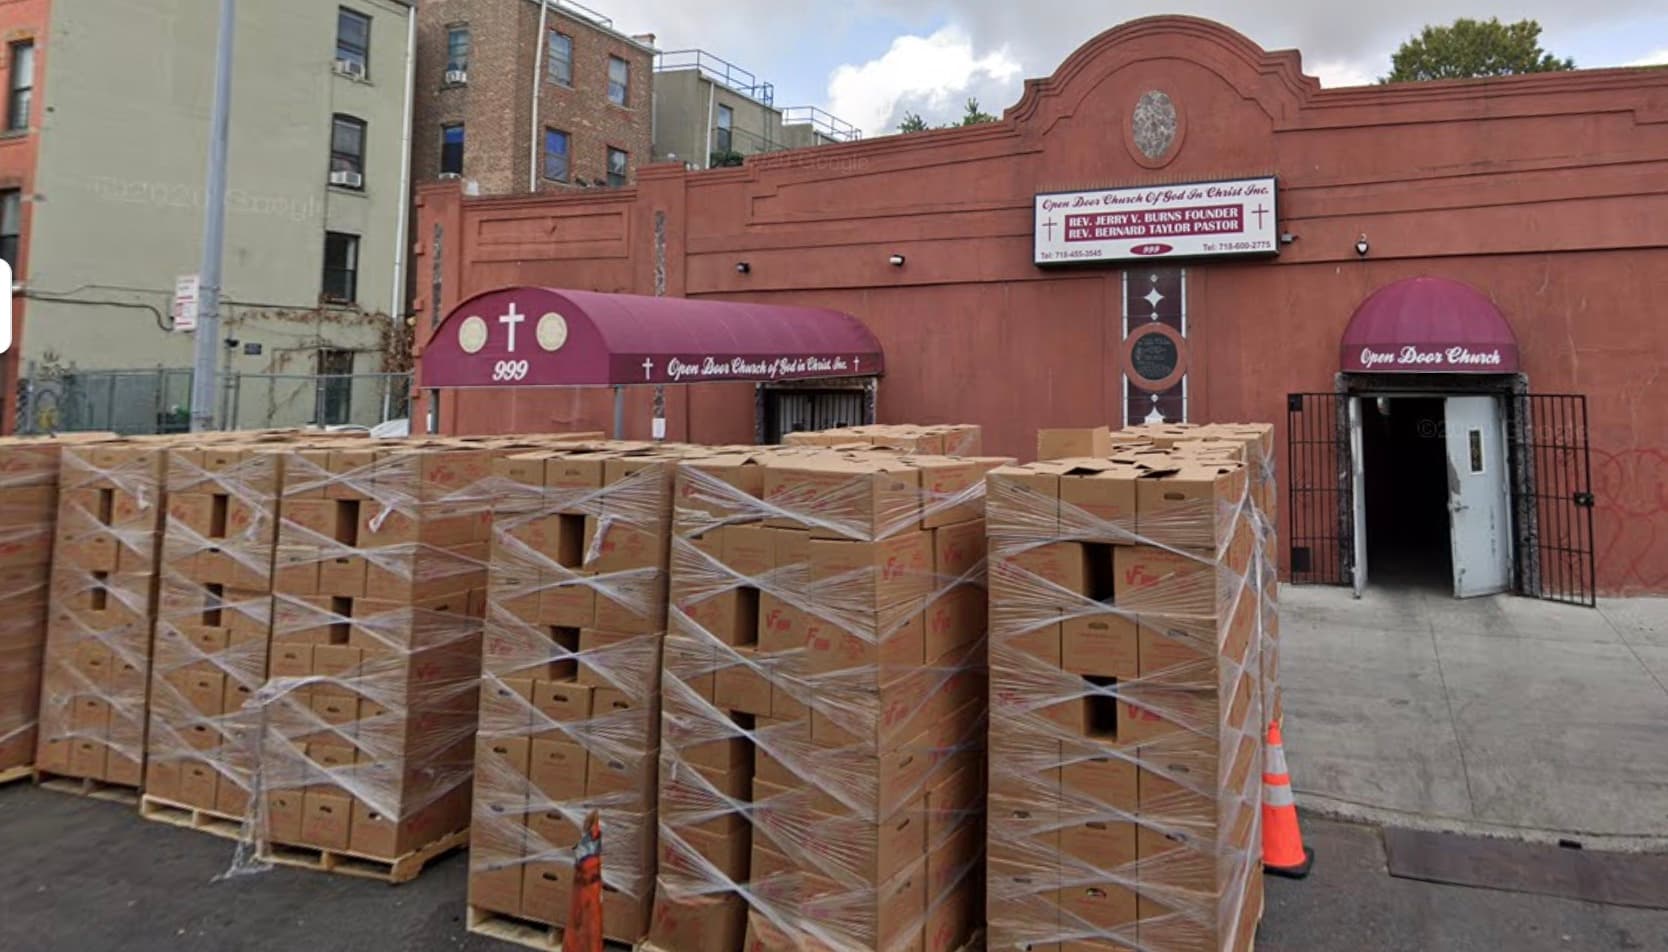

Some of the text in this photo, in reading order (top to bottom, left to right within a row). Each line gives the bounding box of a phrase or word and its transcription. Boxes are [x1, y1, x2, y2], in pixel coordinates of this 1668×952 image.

[1042, 184, 1269, 212] Open Door Church Of God In Christ Inc.
[1069, 207, 1238, 227] REV. JERRY V. BURNS FOUNDER
[1069, 220, 1238, 239] REV. BERNARD TAYLOR PASTOR
[1360, 345, 1501, 369] Open Door Church
[492, 360, 529, 381] 999
[667, 357, 699, 381] Open
[701, 356, 729, 375] Door
[731, 357, 768, 375] Church
[768, 359, 779, 378] of
[779, 357, 798, 375] God
[806, 356, 832, 371] Christ
